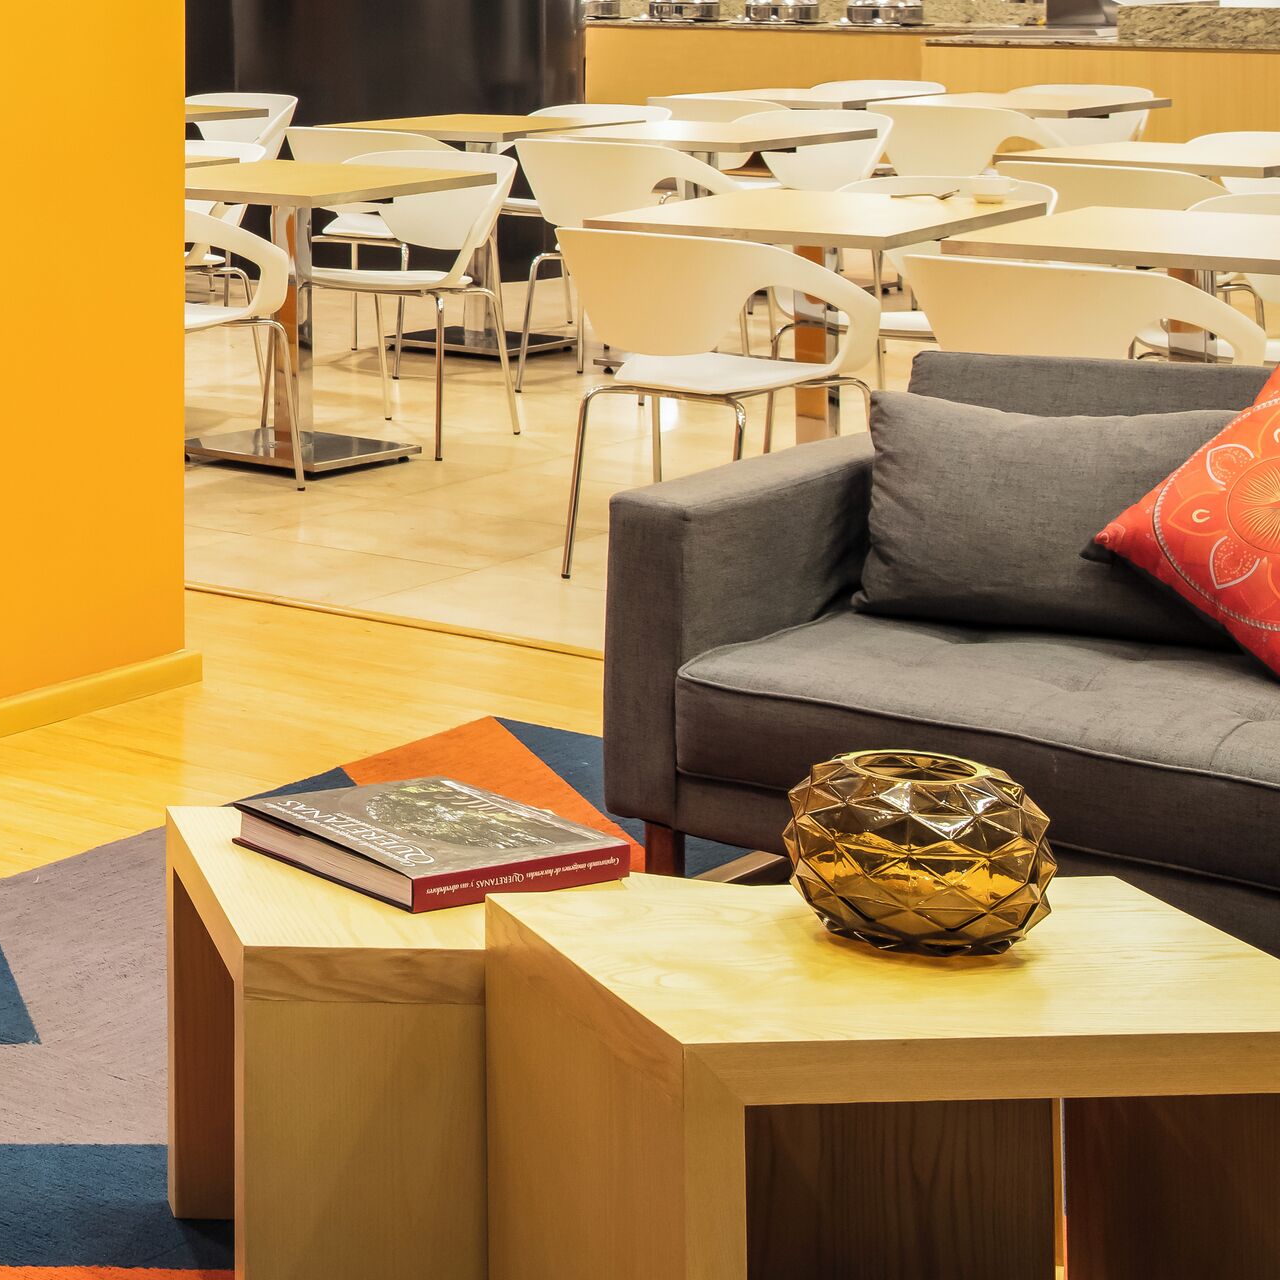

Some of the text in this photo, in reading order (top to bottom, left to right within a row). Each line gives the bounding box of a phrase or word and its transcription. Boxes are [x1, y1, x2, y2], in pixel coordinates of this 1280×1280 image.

[277, 799, 436, 865] QUERETANAS
[586, 856, 620, 869] Capturando
[526, 869, 554, 880] haciendas
[553, 867, 562, 876] de
[469, 879, 475, 888] y
[475, 872, 525, 889] QUERETANAS
[425, 884, 460, 896] alrededores
